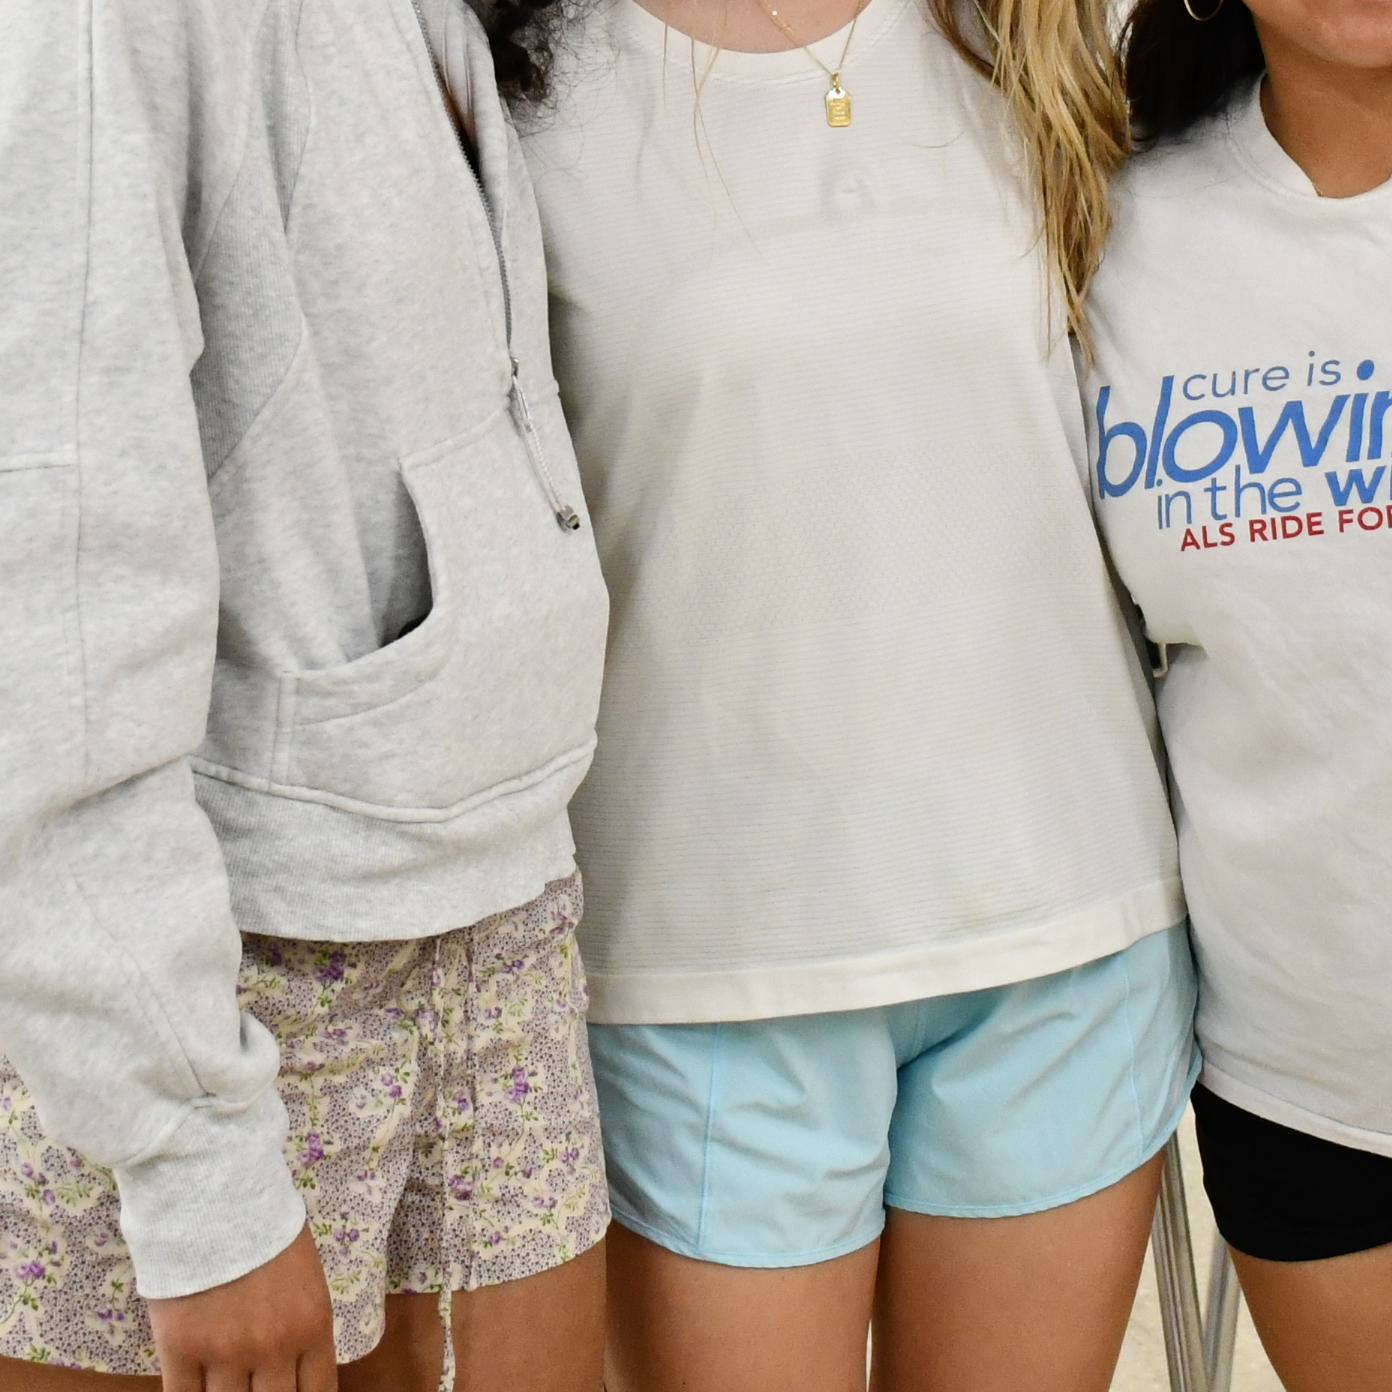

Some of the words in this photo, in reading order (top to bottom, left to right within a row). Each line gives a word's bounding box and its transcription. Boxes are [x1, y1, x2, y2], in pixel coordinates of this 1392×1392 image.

[1182, 365, 1290, 402] cure
[1307, 350, 1342, 388] is
[1156, 479, 1194, 530] in
[1203, 465, 1303, 522] the
[1180, 521, 1236, 553] ALS
[1248, 511, 1325, 543] RIDE
